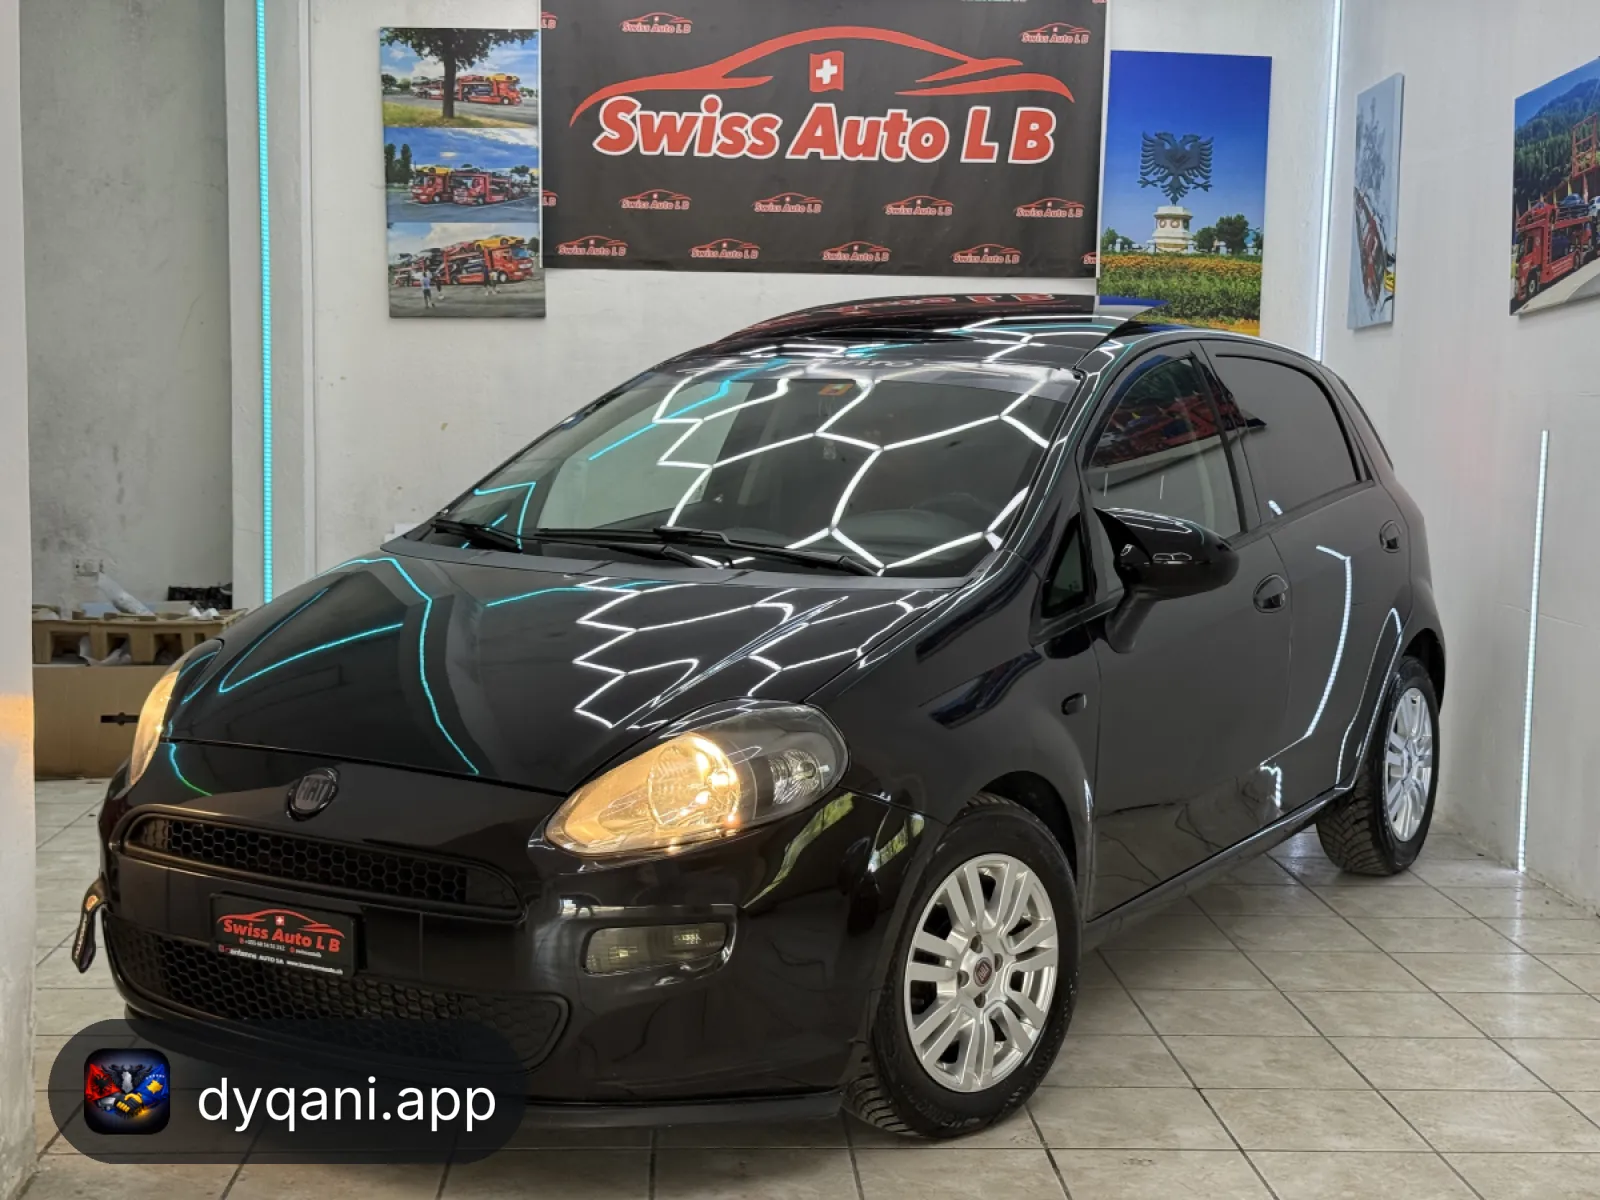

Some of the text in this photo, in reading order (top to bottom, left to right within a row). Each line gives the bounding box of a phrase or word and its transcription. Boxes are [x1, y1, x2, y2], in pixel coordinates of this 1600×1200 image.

[622, 22, 649, 32] Swiss
[650, 23, 675, 33] Auto
[682, 24, 691, 34] B
[1021, 32, 1049, 43] Swiss
[1049, 33, 1073, 43] Auto
[1081, 34, 1089, 44] B
[592, 94, 1057, 164] Swiss Auto L B
[621, 200, 649, 209] Swiss
[650, 200, 674, 209] Auto
[681, 201, 690, 210] B
[754, 202, 781, 212] Swiss
[782, 203, 806, 213] Auto
[813, 203, 822, 213] B
[885, 205, 913, 215] Swiss
[913, 205, 937, 216] Auto
[944, 207, 953, 216] B
[1016, 207, 1044, 217] Swiss
[1044, 208, 1067, 218] Auto
[1074, 208, 1083, 218] B
[558, 245, 585, 256] Swiss
[586, 246, 611, 256] Auto
[618, 247, 626, 257] B
[691, 248, 718, 258] Swiss
[719, 249, 743, 259] Auto
[750, 250, 759, 260] B
[823, 251, 850, 261] Swiss
[850, 252, 874, 262] Auto
[881, 252, 890, 262] B
[953, 253, 980, 263] Swiss
[980, 254, 1004, 264] Auto
[1011, 255, 1020, 264] B
[223, 919, 269, 940] Swiss
[272, 928, 312, 947] Auto
[316, 936, 325, 950] L
[328, 938, 340, 953] B
